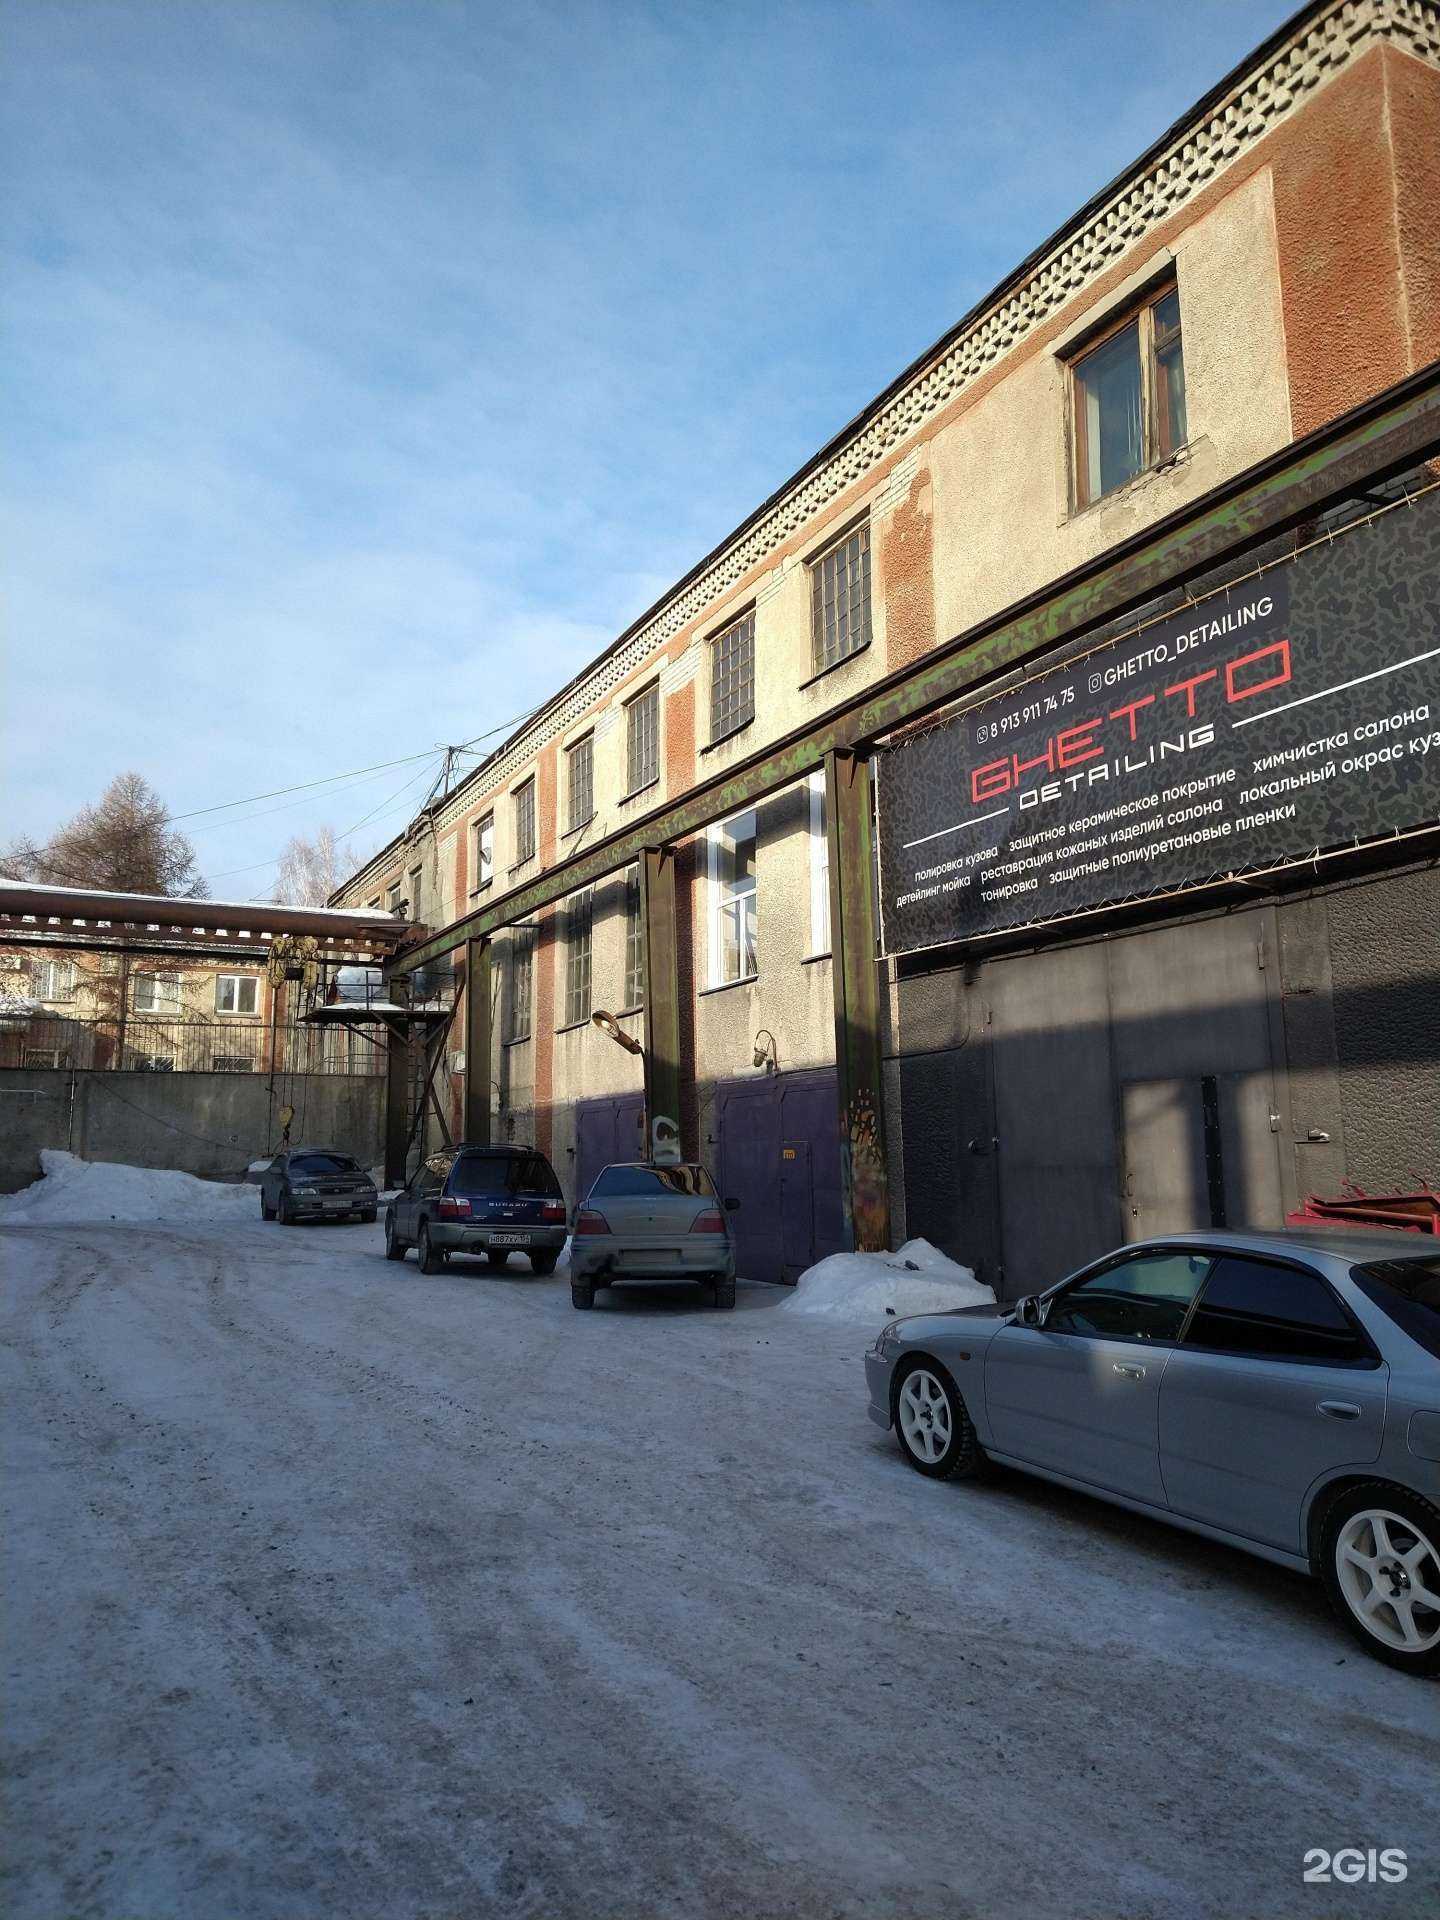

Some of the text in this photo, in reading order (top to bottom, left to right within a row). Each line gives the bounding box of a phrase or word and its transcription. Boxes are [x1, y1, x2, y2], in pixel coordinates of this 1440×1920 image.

[1104, 596, 1274, 686] GHETTO_DETAILING
[971, 639, 1292, 804] GHETTO
[990, 685, 1075, 738] 8 913 911 74 75
[914, 704, 1430, 883] полировка кузова защитное керамическое покрытие химчистка салона
[1019, 722, 1215, 811] DETAILING
[896, 885, 940, 909] детейлинг
[942, 876, 971, 894] мойка
[980, 852, 1054, 884] реставрация
[1056, 835, 1109, 863] кожаных
[1110, 814, 1164, 846] изделий
[1167, 798, 1223, 825] салона
[1239, 761, 1336, 805] локальный
[1341, 741, 1404, 774] окрас
[980, 803, 1297, 903] тонировка защитные полиуретановые пленки
